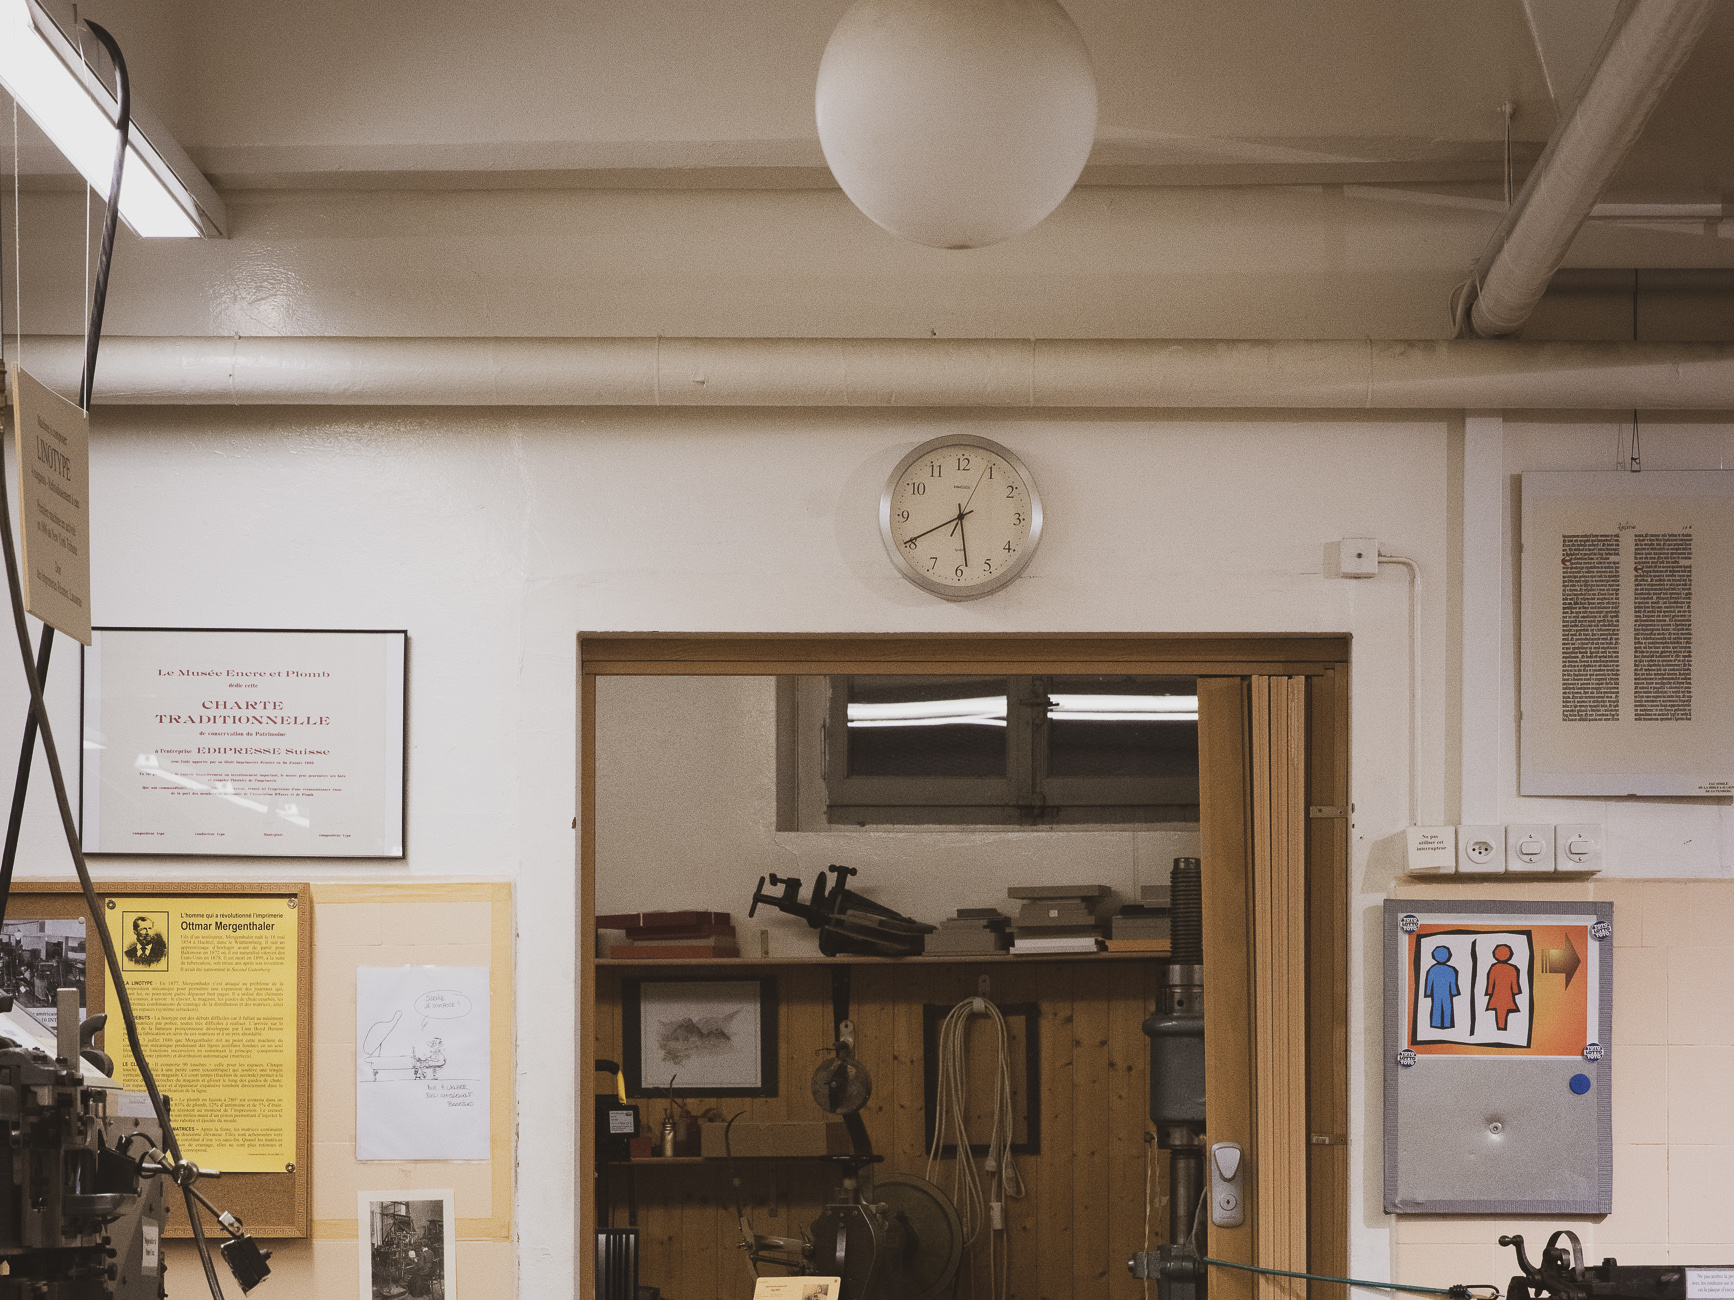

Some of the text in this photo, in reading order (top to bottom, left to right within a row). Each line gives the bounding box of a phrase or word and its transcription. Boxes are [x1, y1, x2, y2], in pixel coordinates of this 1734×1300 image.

[36, 435, 71, 482] LINOTYPE
[956, 458, 970, 471] 12
[930, 464, 942, 477] 11
[988, 466, 994, 479] 1
[911, 482, 925, 495] 10
[1006, 485, 1014, 498] 2
[901, 510, 910, 523] 9
[1013, 513, 1021, 526] 3
[909, 537, 917, 550] 8
[1003, 540, 1011, 553] 4
[929, 557, 937, 570] 7
[984, 559, 992, 572] 5
[955, 565, 963, 577] 6
[202, 700, 284, 710] CHARTE
[155, 715, 330, 725] TRADITIONNELLE
[181, 921, 274, 933] Ottmar Mergenthaler
